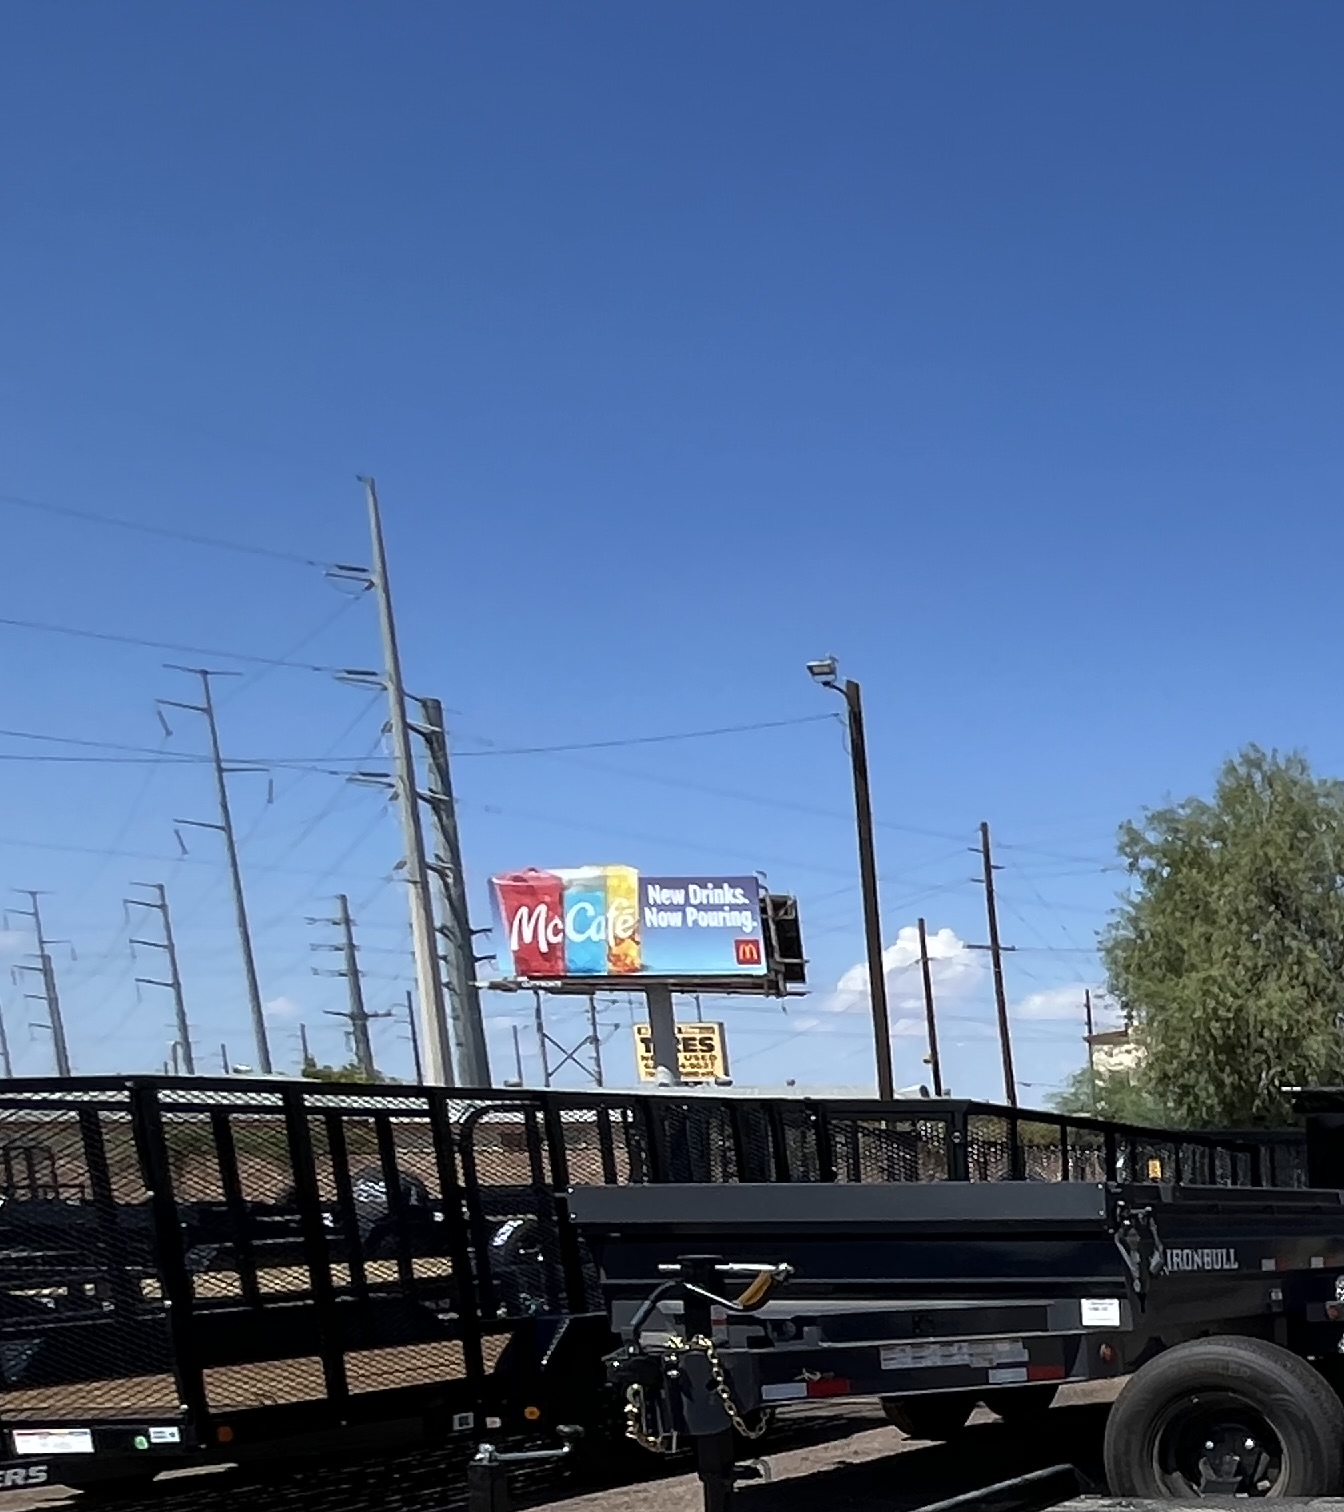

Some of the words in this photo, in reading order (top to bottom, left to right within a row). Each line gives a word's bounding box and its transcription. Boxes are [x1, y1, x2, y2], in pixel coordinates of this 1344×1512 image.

[647, 884, 685, 905] New
[688, 883, 750, 905] Drinks.
[644, 906, 682, 927] Now
[685, 906, 758, 934] Pouring.
[640, 1036, 714, 1053] TES
[1166, 1249, 1239, 1271] IRONBULL
[0, 1464, 48, 1487] RS
